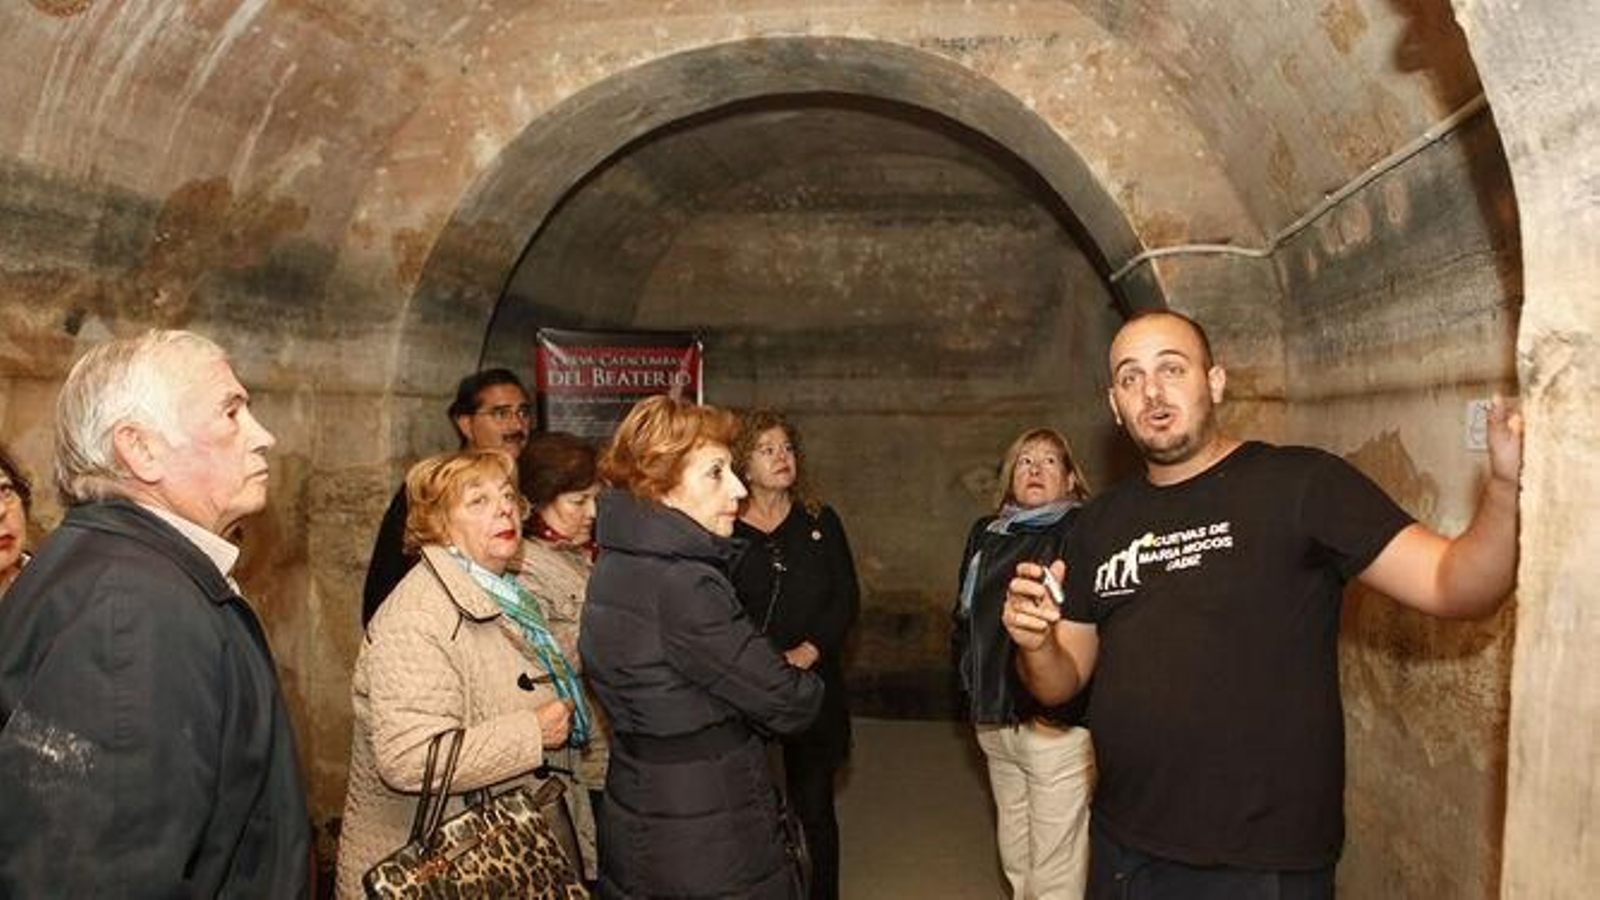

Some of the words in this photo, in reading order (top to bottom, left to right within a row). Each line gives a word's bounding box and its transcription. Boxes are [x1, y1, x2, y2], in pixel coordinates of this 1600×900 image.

[548, 370, 585, 386] DEL
[593, 368, 691, 388] BEATERIO
[1208, 521, 1231, 535] DE
